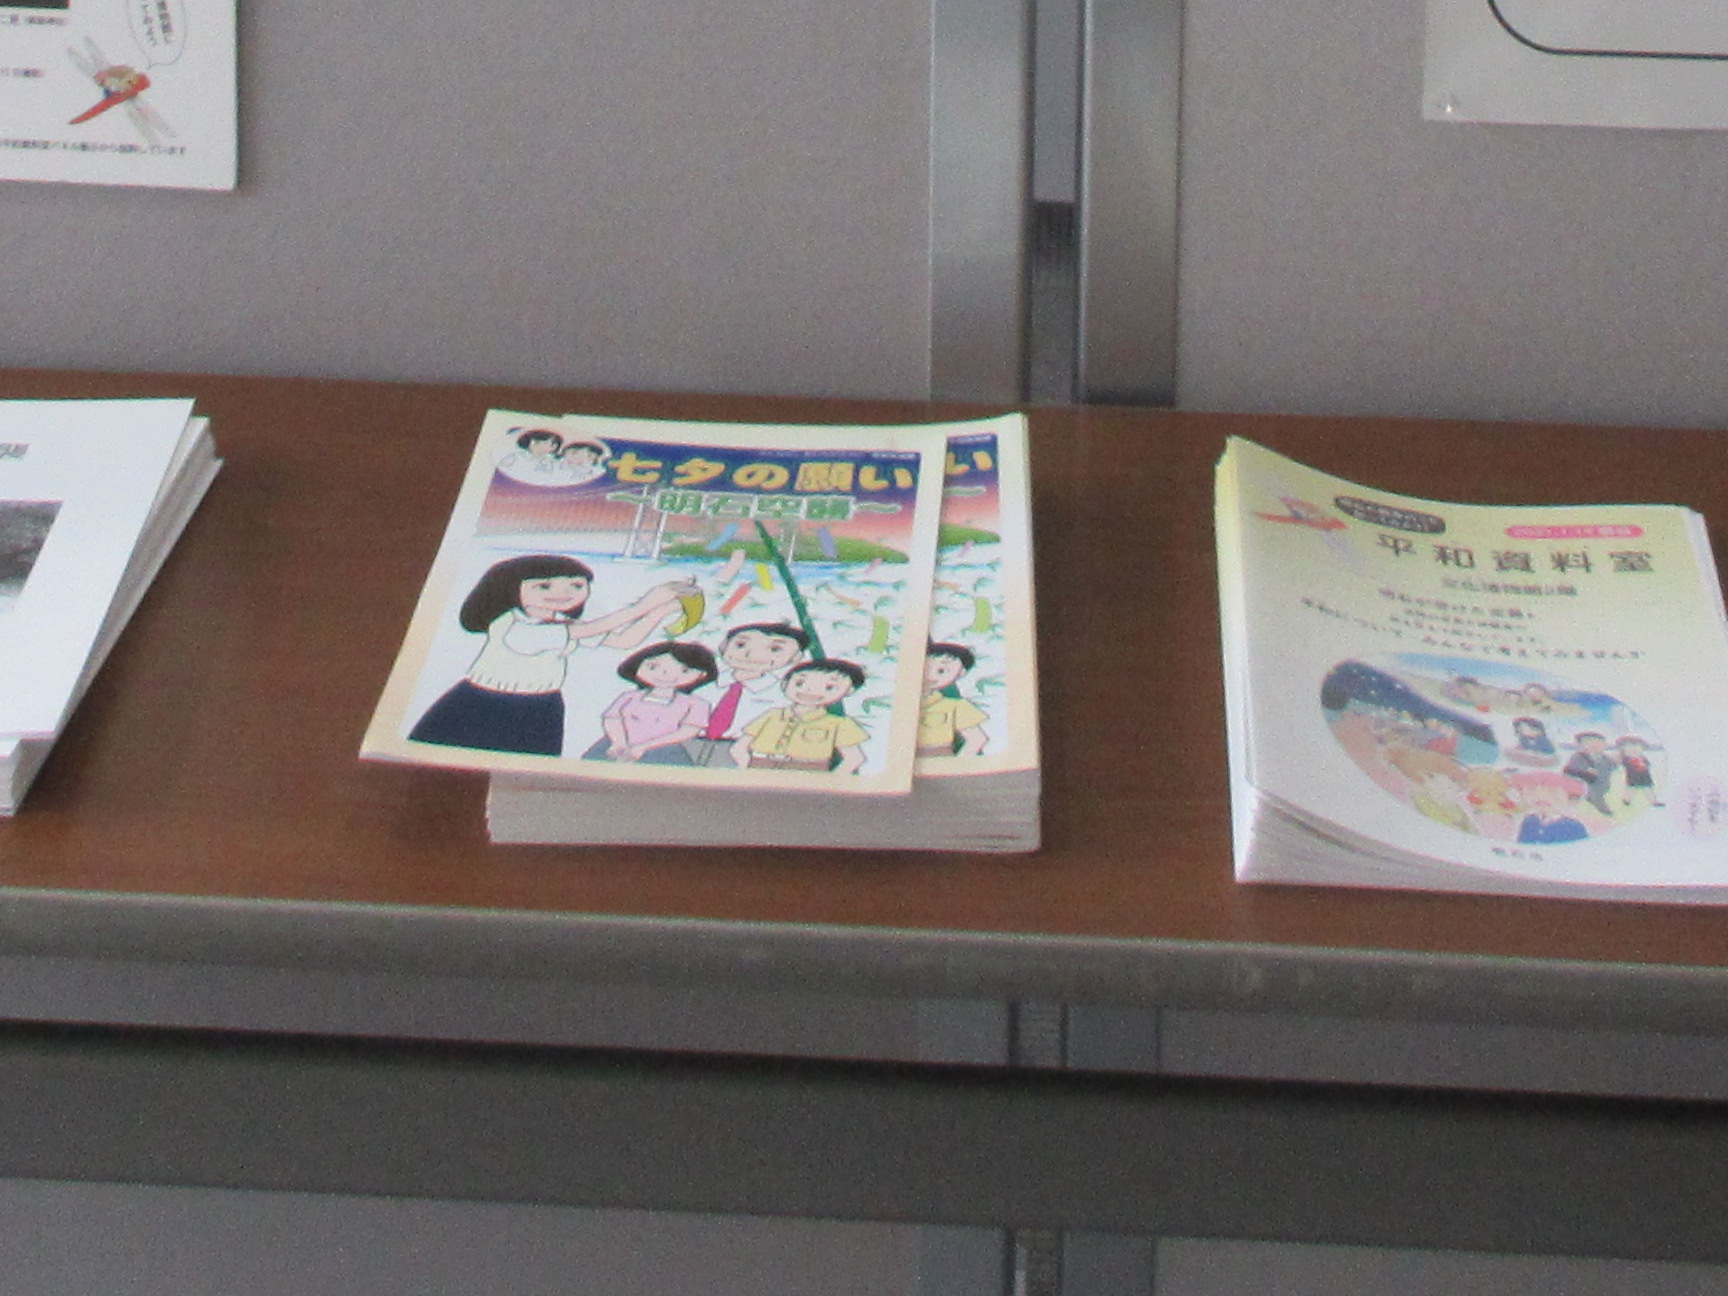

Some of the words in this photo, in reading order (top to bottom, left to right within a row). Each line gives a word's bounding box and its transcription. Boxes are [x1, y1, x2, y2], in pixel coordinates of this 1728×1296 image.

[608, 452, 915, 492] 七夕の願い
[1376, 532, 1655, 575] 平和資料室
